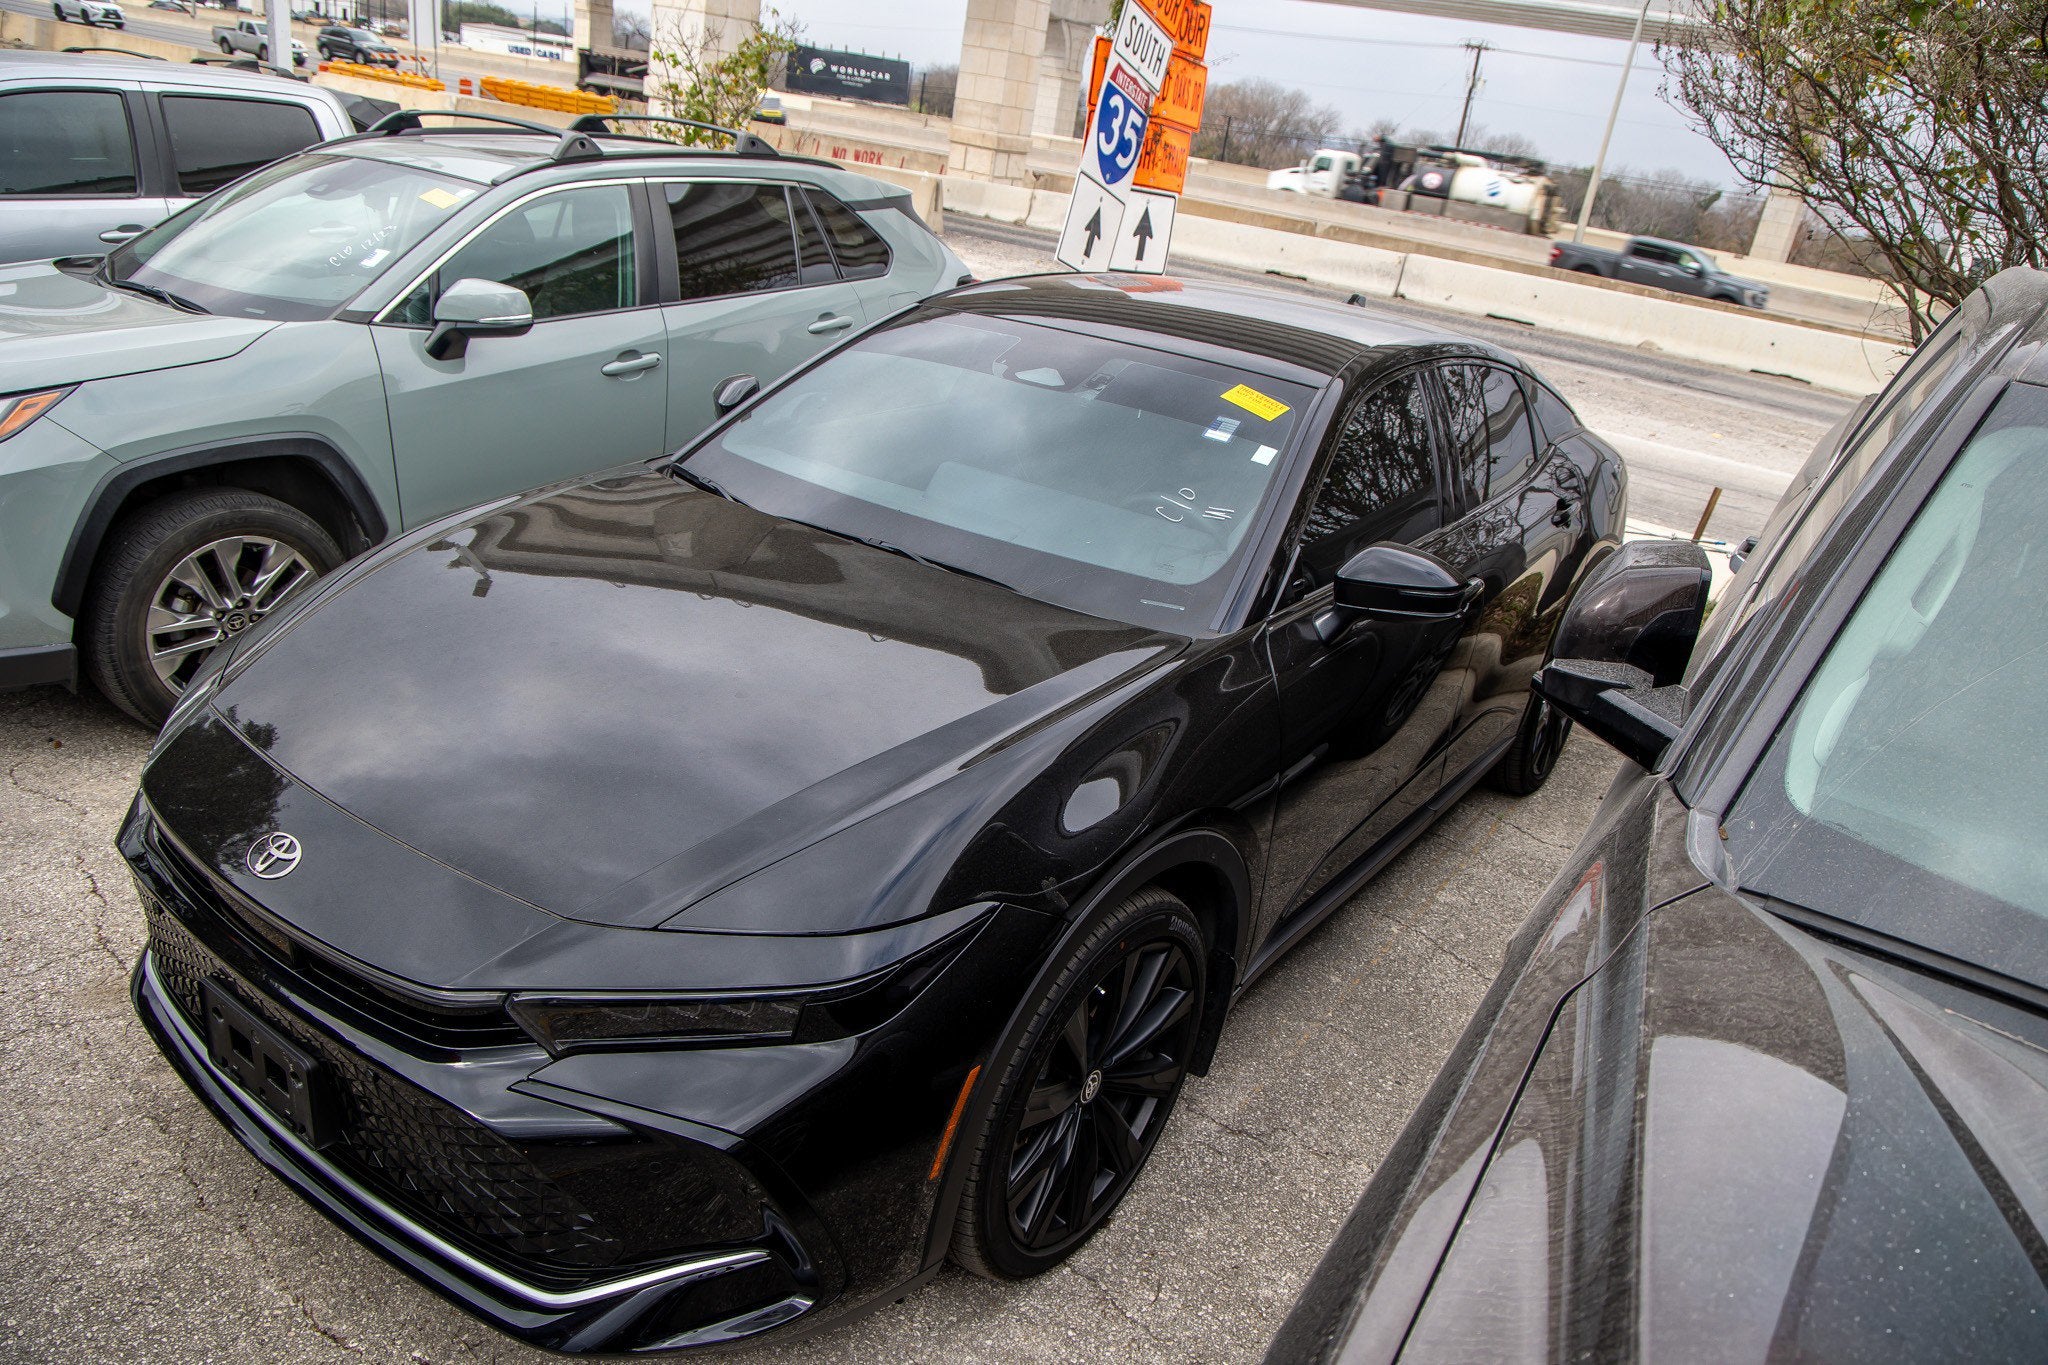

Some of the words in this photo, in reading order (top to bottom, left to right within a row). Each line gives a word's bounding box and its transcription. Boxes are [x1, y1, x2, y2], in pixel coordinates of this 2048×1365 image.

[508, 45, 531, 56] USED
[1124, 14, 1166, 78] SOUTH
[1115, 69, 1149, 110] INTERSTATE
[1098, 94, 1143, 169] 35
[832, 146, 847, 159] NO
[853, 150, 885, 166] WORK
